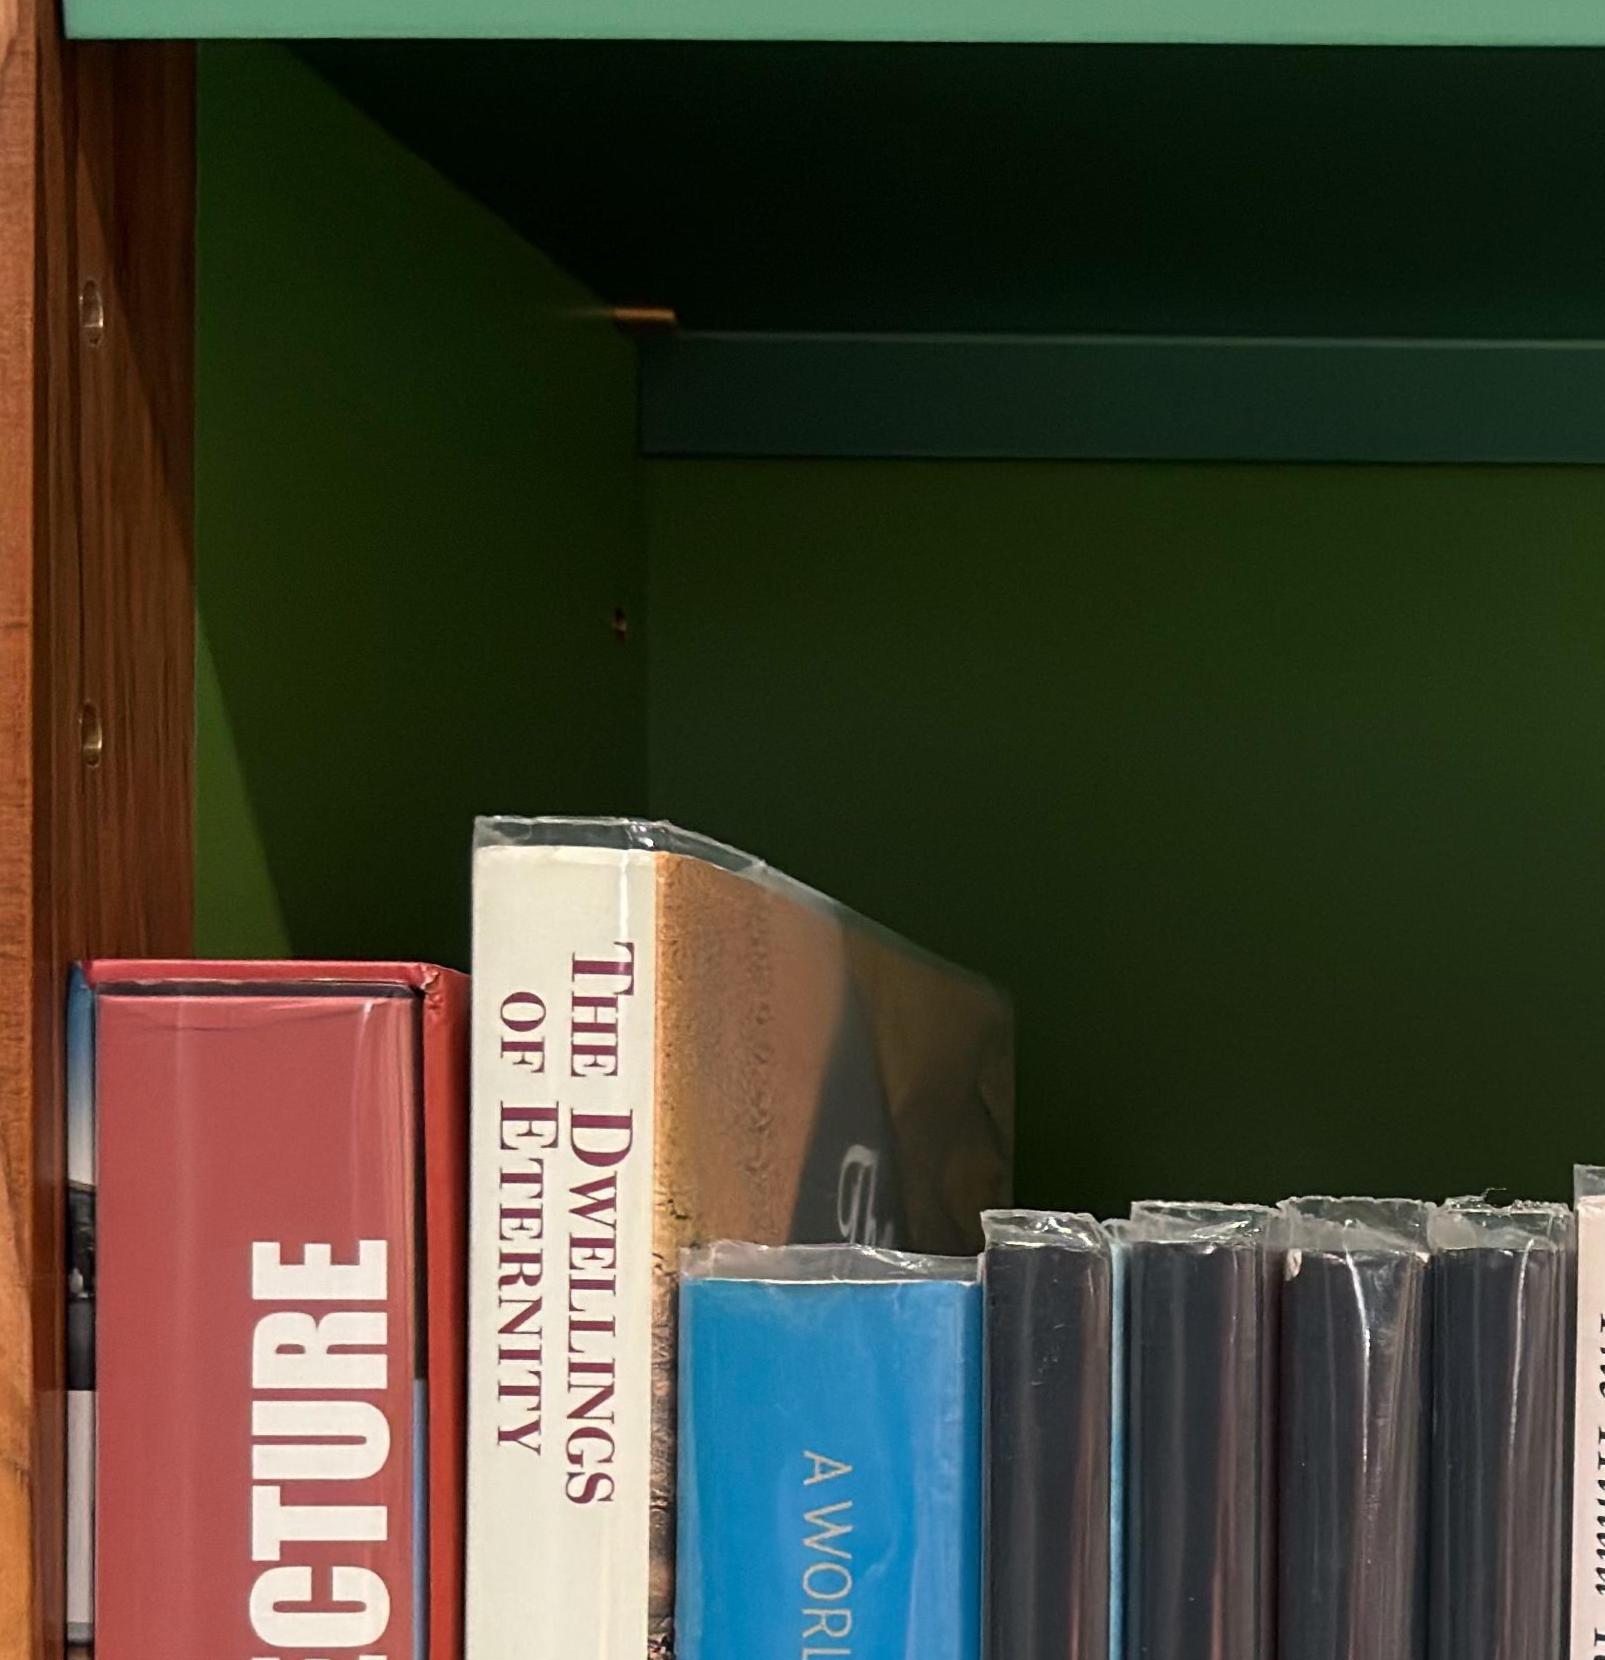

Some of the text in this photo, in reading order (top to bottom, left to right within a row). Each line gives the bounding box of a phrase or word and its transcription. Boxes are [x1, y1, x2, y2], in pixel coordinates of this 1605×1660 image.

[496, 990, 557, 1456] OF ETERNITY
[565, 940, 636, 1505] THE DWELLINGS
[800, 1450, 852, 1487] A
